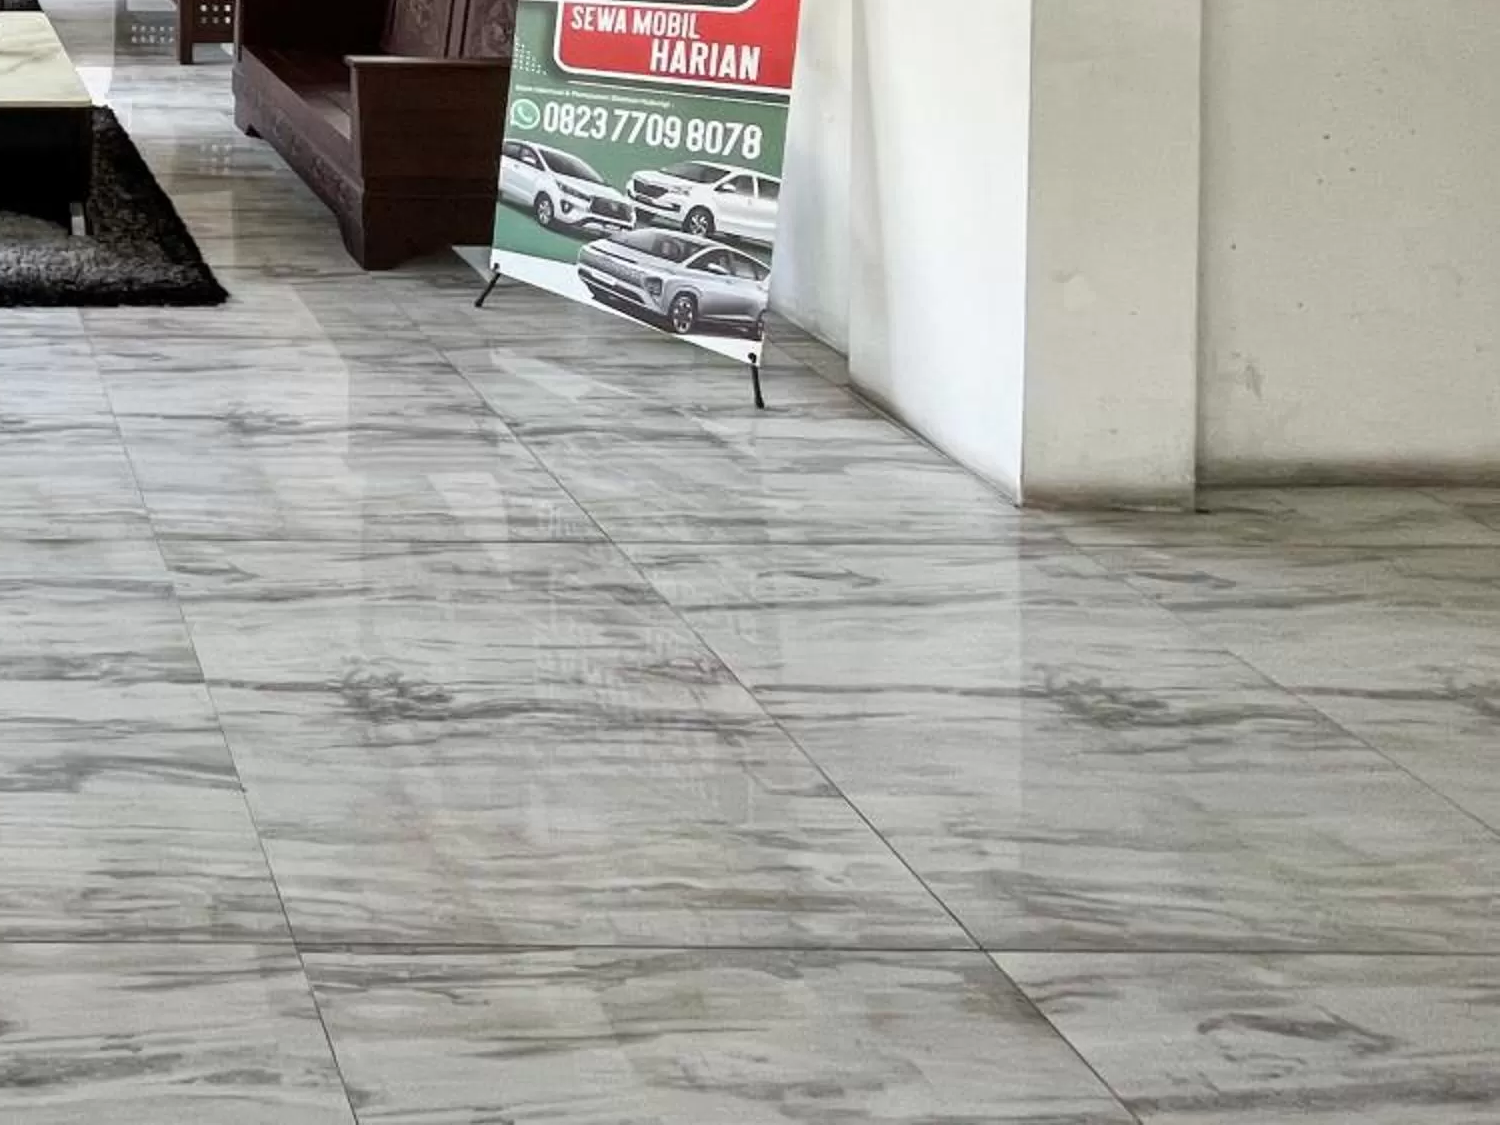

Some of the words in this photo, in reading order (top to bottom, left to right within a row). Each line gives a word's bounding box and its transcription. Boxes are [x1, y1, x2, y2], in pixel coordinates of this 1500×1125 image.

[570, 5, 627, 34] SEWA
[631, 9, 701, 40] MOBIL
[650, 38, 761, 82] HARIAN
[542, 101, 608, 140] 0823
[610, 108, 682, 150] 7709
[685, 117, 763, 160] 8078
